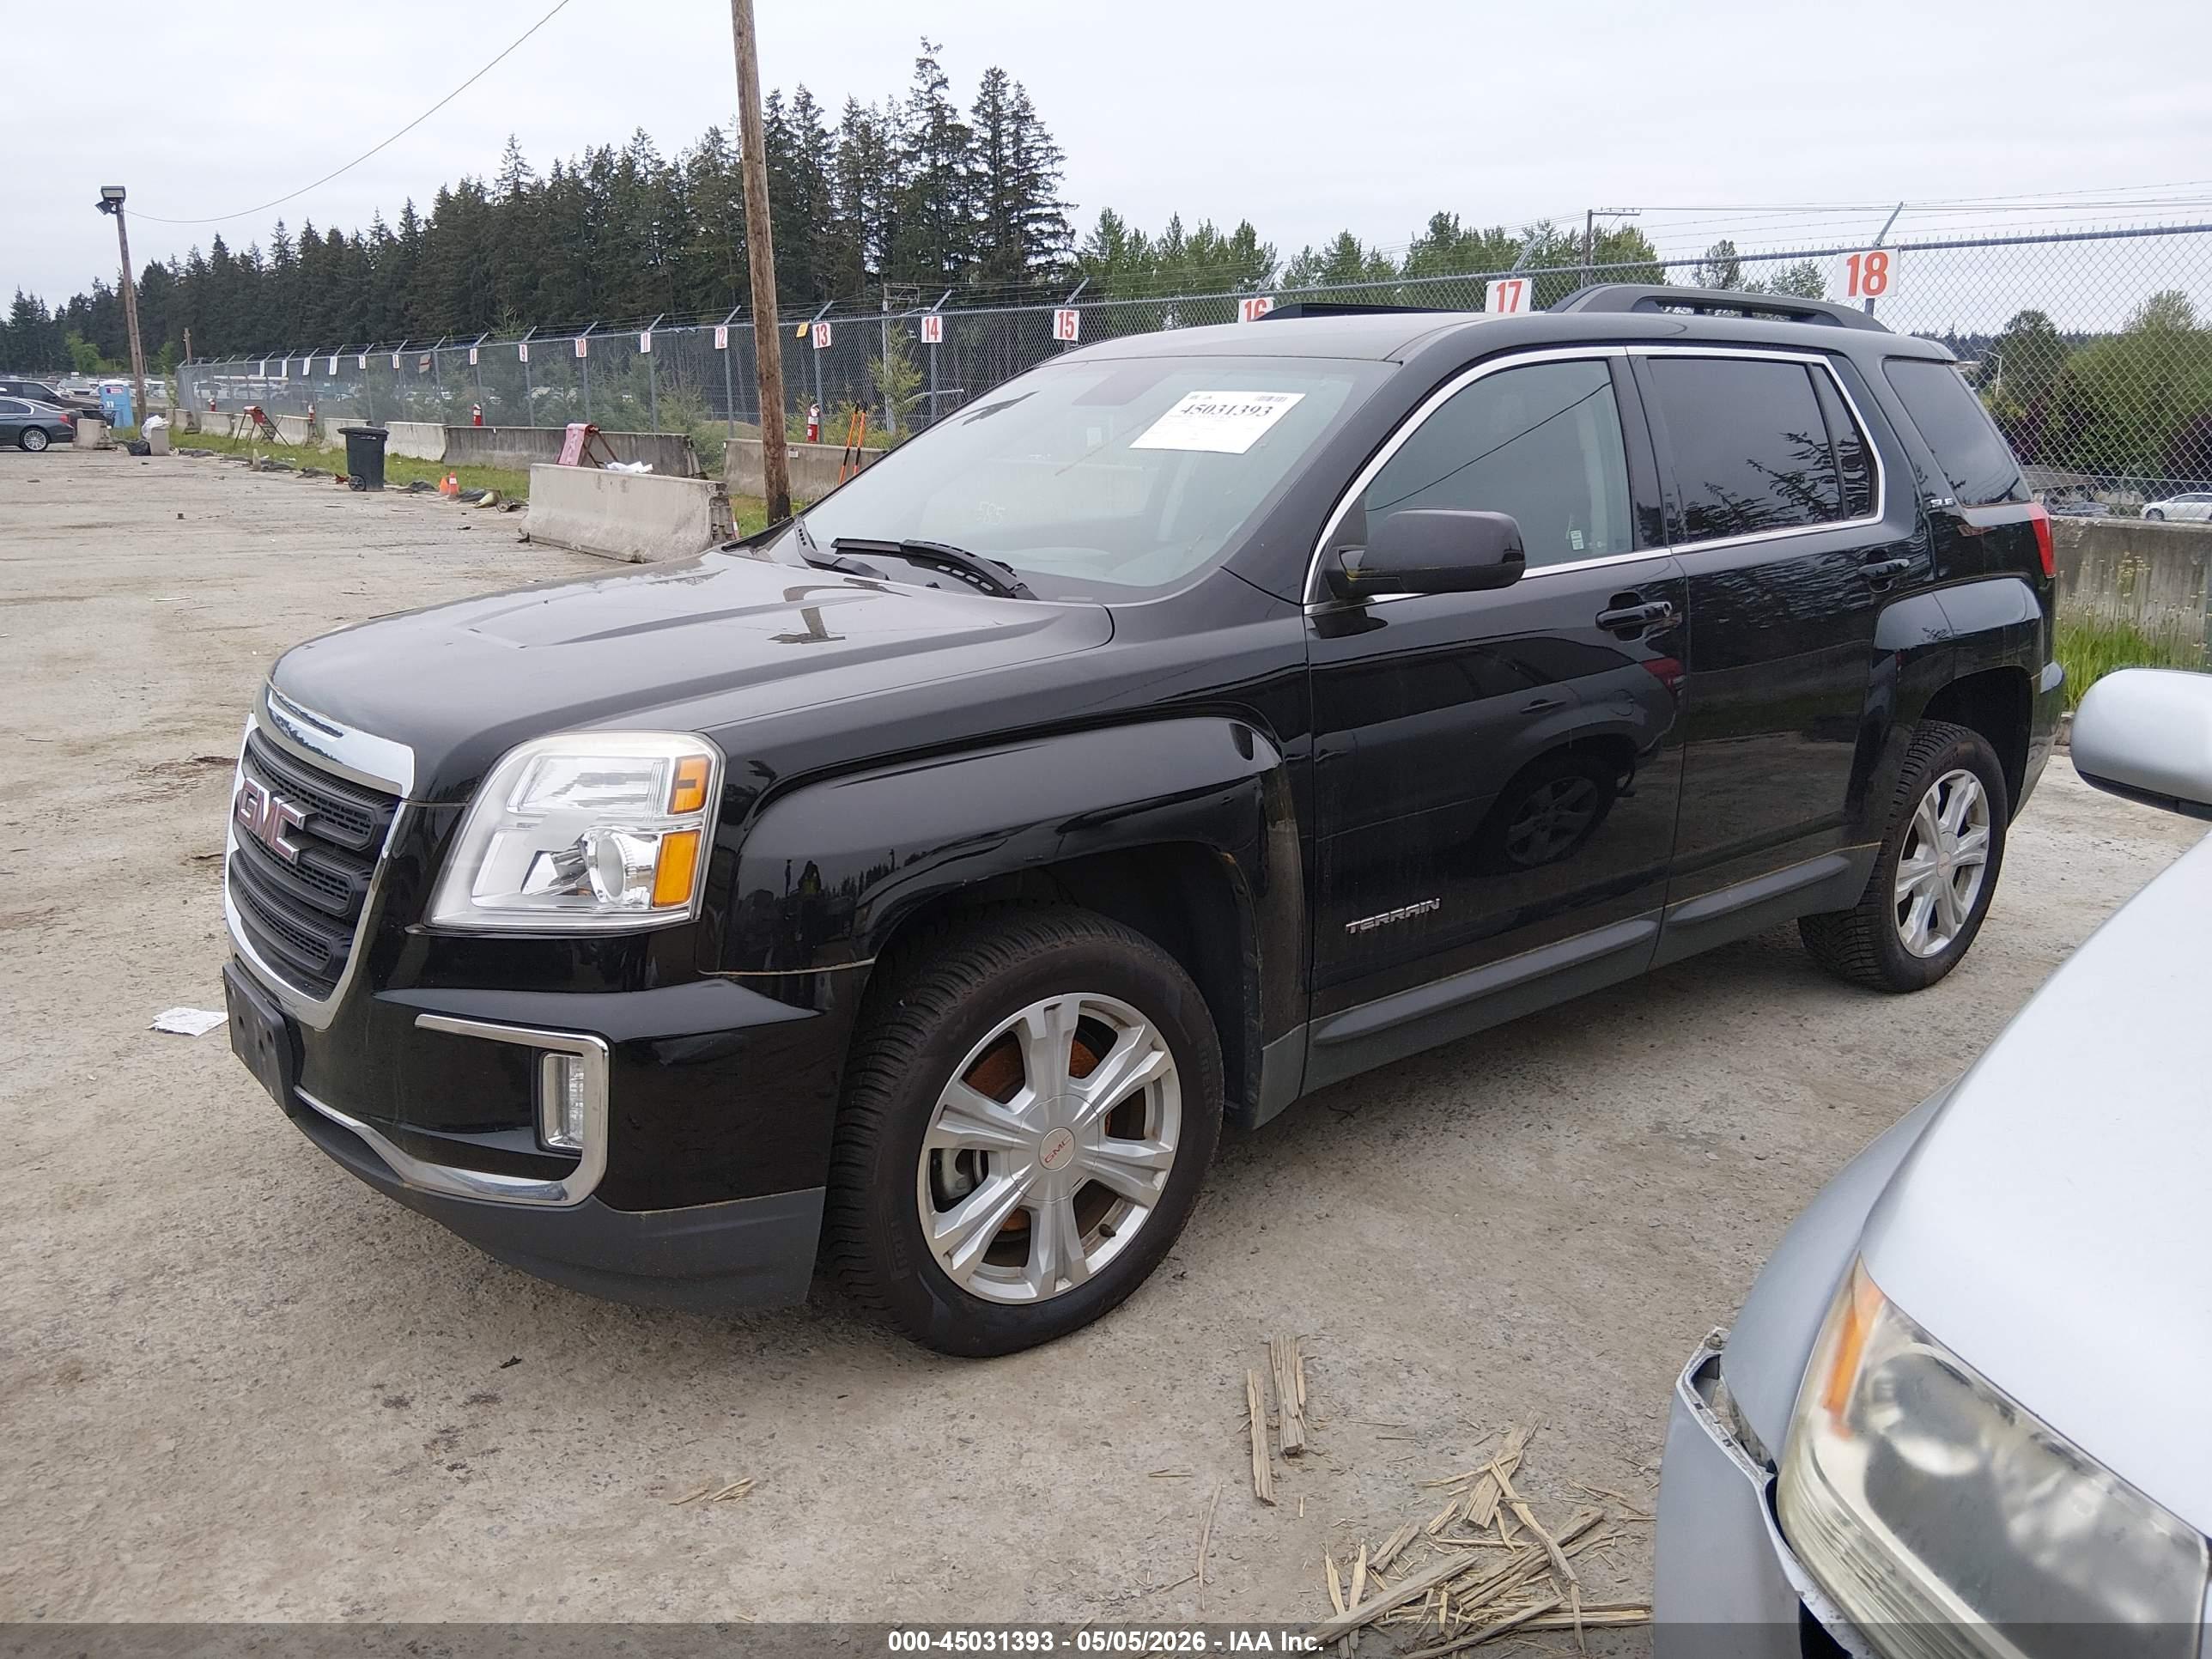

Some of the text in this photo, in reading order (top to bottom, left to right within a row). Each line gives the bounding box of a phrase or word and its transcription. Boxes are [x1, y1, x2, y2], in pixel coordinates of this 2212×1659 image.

[1846, 252, 1888, 297] 18
[1496, 281, 1522, 313] 17
[717, 328, 726, 348] 12
[816, 324, 828, 347] 13
[925, 317, 939, 342] 14
[1058, 311, 1075, 339] 15
[577, 339, 585, 356] 10
[642, 333, 649, 351] 11
[1181, 404, 1274, 417] 45031393
[237, 776, 307, 866] GMC
[1346, 897, 1440, 934] TERRAIN
[1044, 1133, 1073, 1164] GMC
